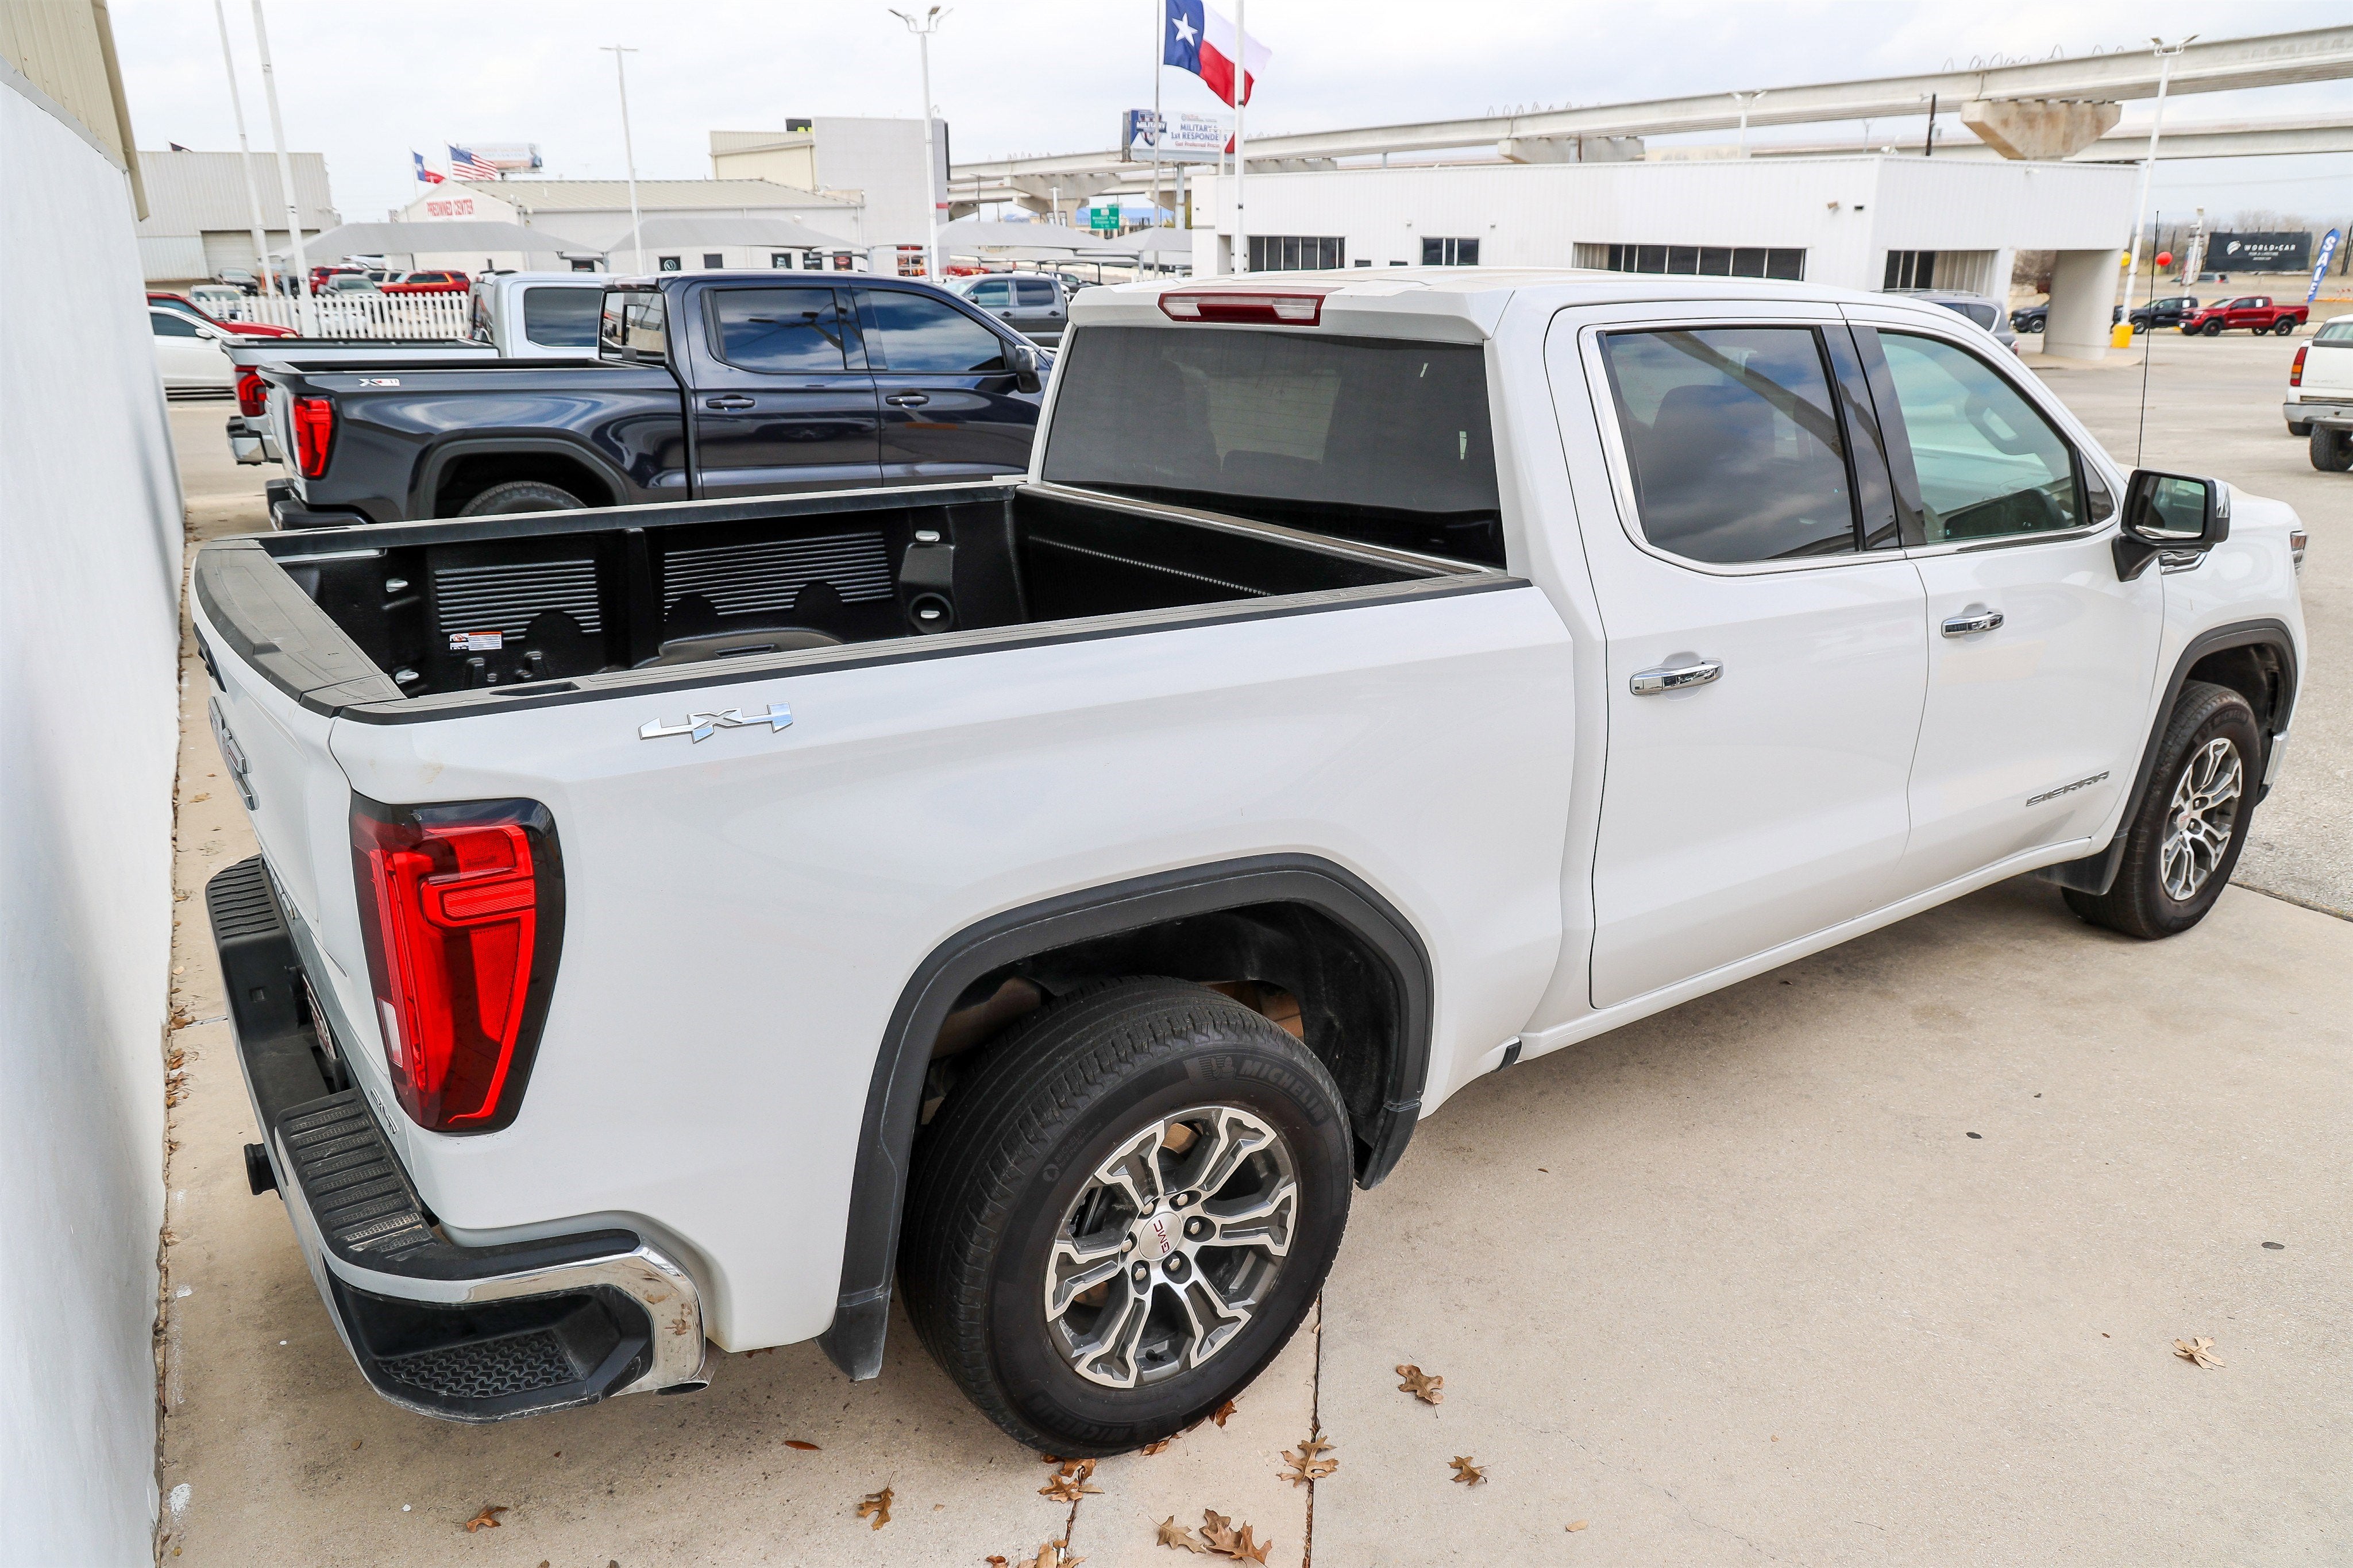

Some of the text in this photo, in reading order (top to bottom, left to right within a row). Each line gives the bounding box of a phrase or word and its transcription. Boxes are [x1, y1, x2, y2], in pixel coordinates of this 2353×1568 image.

[1183, 132, 1227, 141] RESPONDES
[453, 199, 474, 215] CENTER
[2308, 235, 2336, 295] SALE
[2026, 770, 2109, 806] SIERRA
[1239, 1060, 1327, 1122] MICHELIN
[1055, 1126, 1086, 1163] MICHELIN
[1153, 1219, 1170, 1253] GMC
